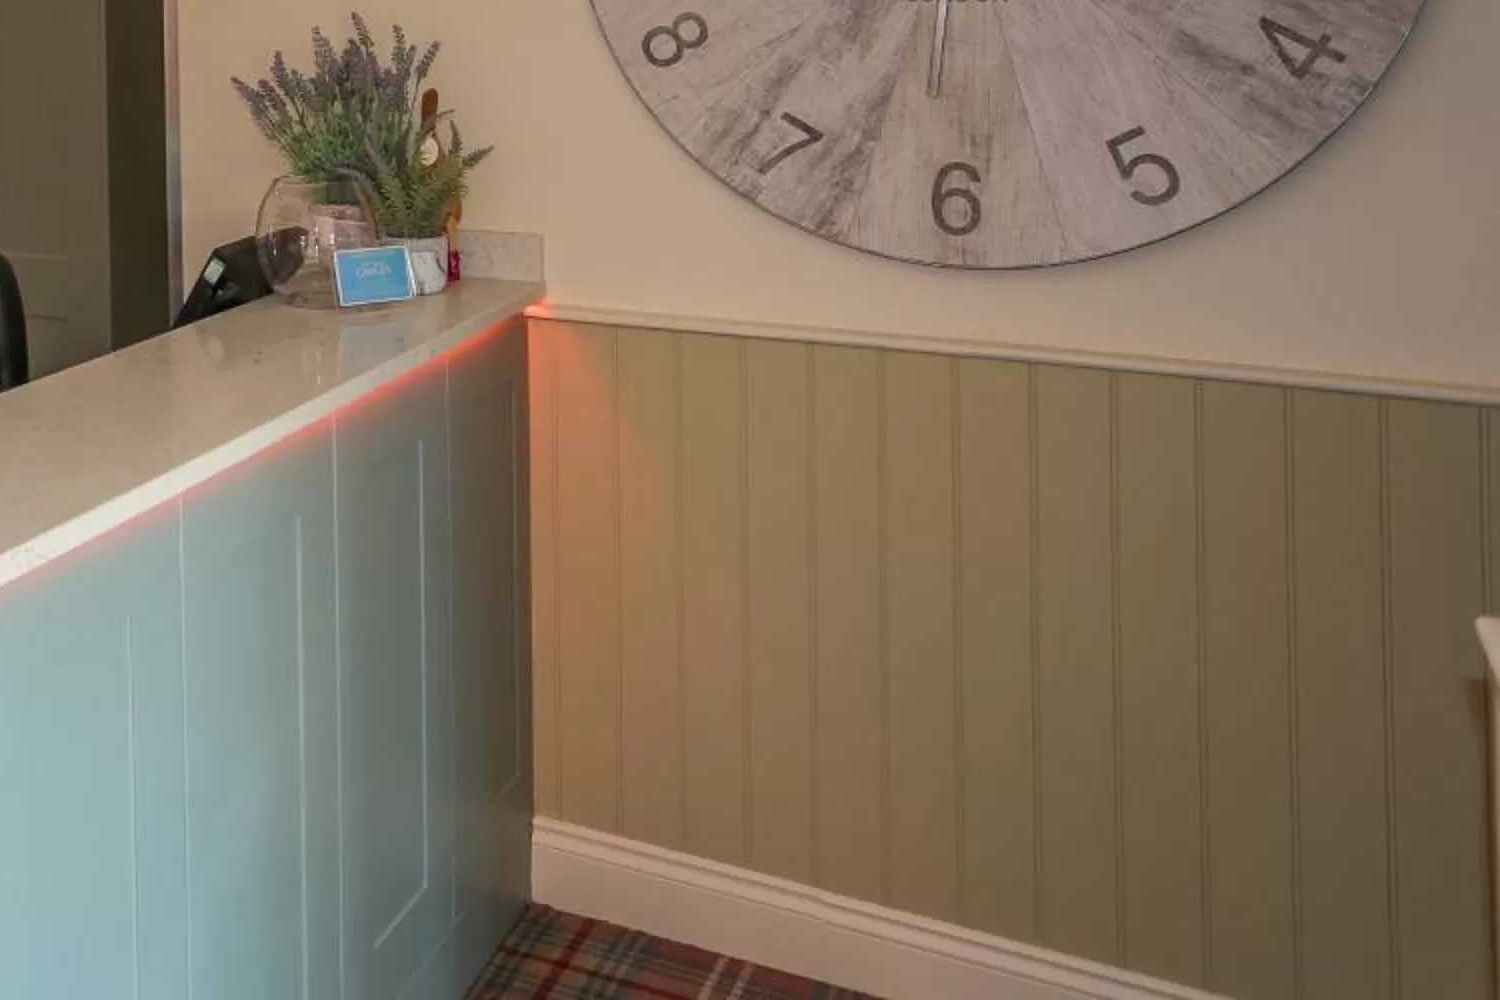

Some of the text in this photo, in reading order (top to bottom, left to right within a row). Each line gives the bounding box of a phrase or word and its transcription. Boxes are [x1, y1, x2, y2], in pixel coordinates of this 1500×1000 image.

[642, 12, 709, 67] 8
[1258, 14, 1346, 80] 4
[758, 112, 823, 177] 7
[1105, 127, 1180, 205] 5
[930, 162, 982, 235] 6
